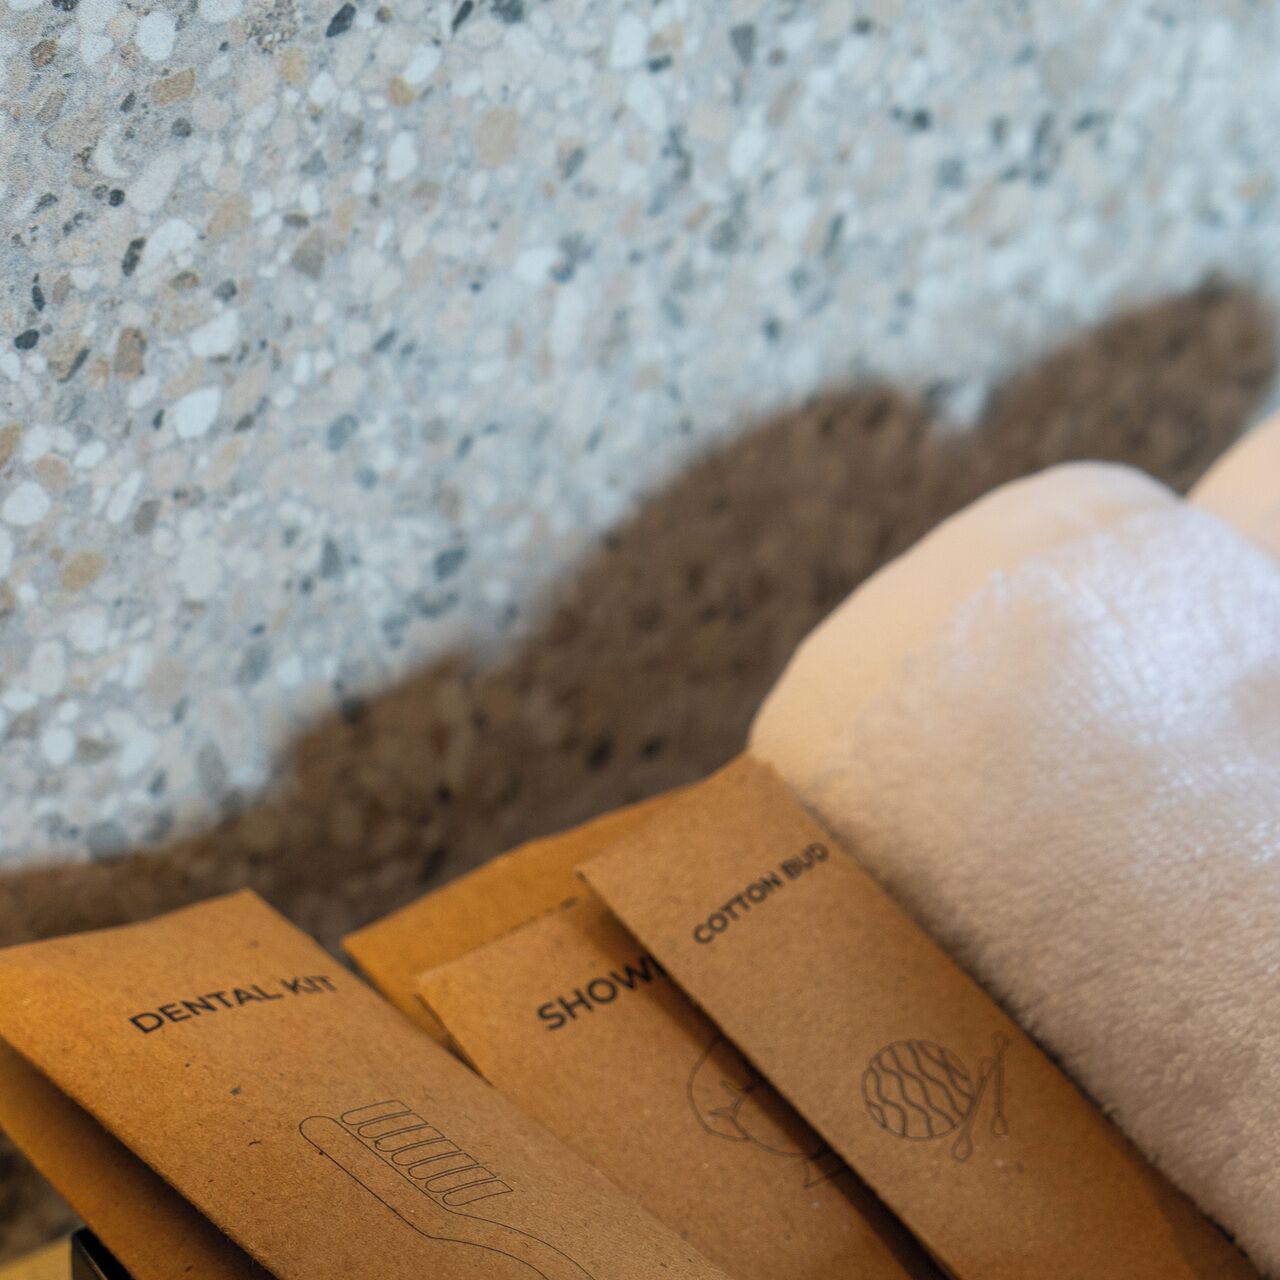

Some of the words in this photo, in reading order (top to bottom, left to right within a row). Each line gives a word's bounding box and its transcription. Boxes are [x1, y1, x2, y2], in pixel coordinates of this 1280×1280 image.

[693, 871, 783, 944] COTTON
[780, 842, 830, 880] BUD
[129, 985, 284, 1034] DENTAL
[280, 974, 337, 995] KIT
